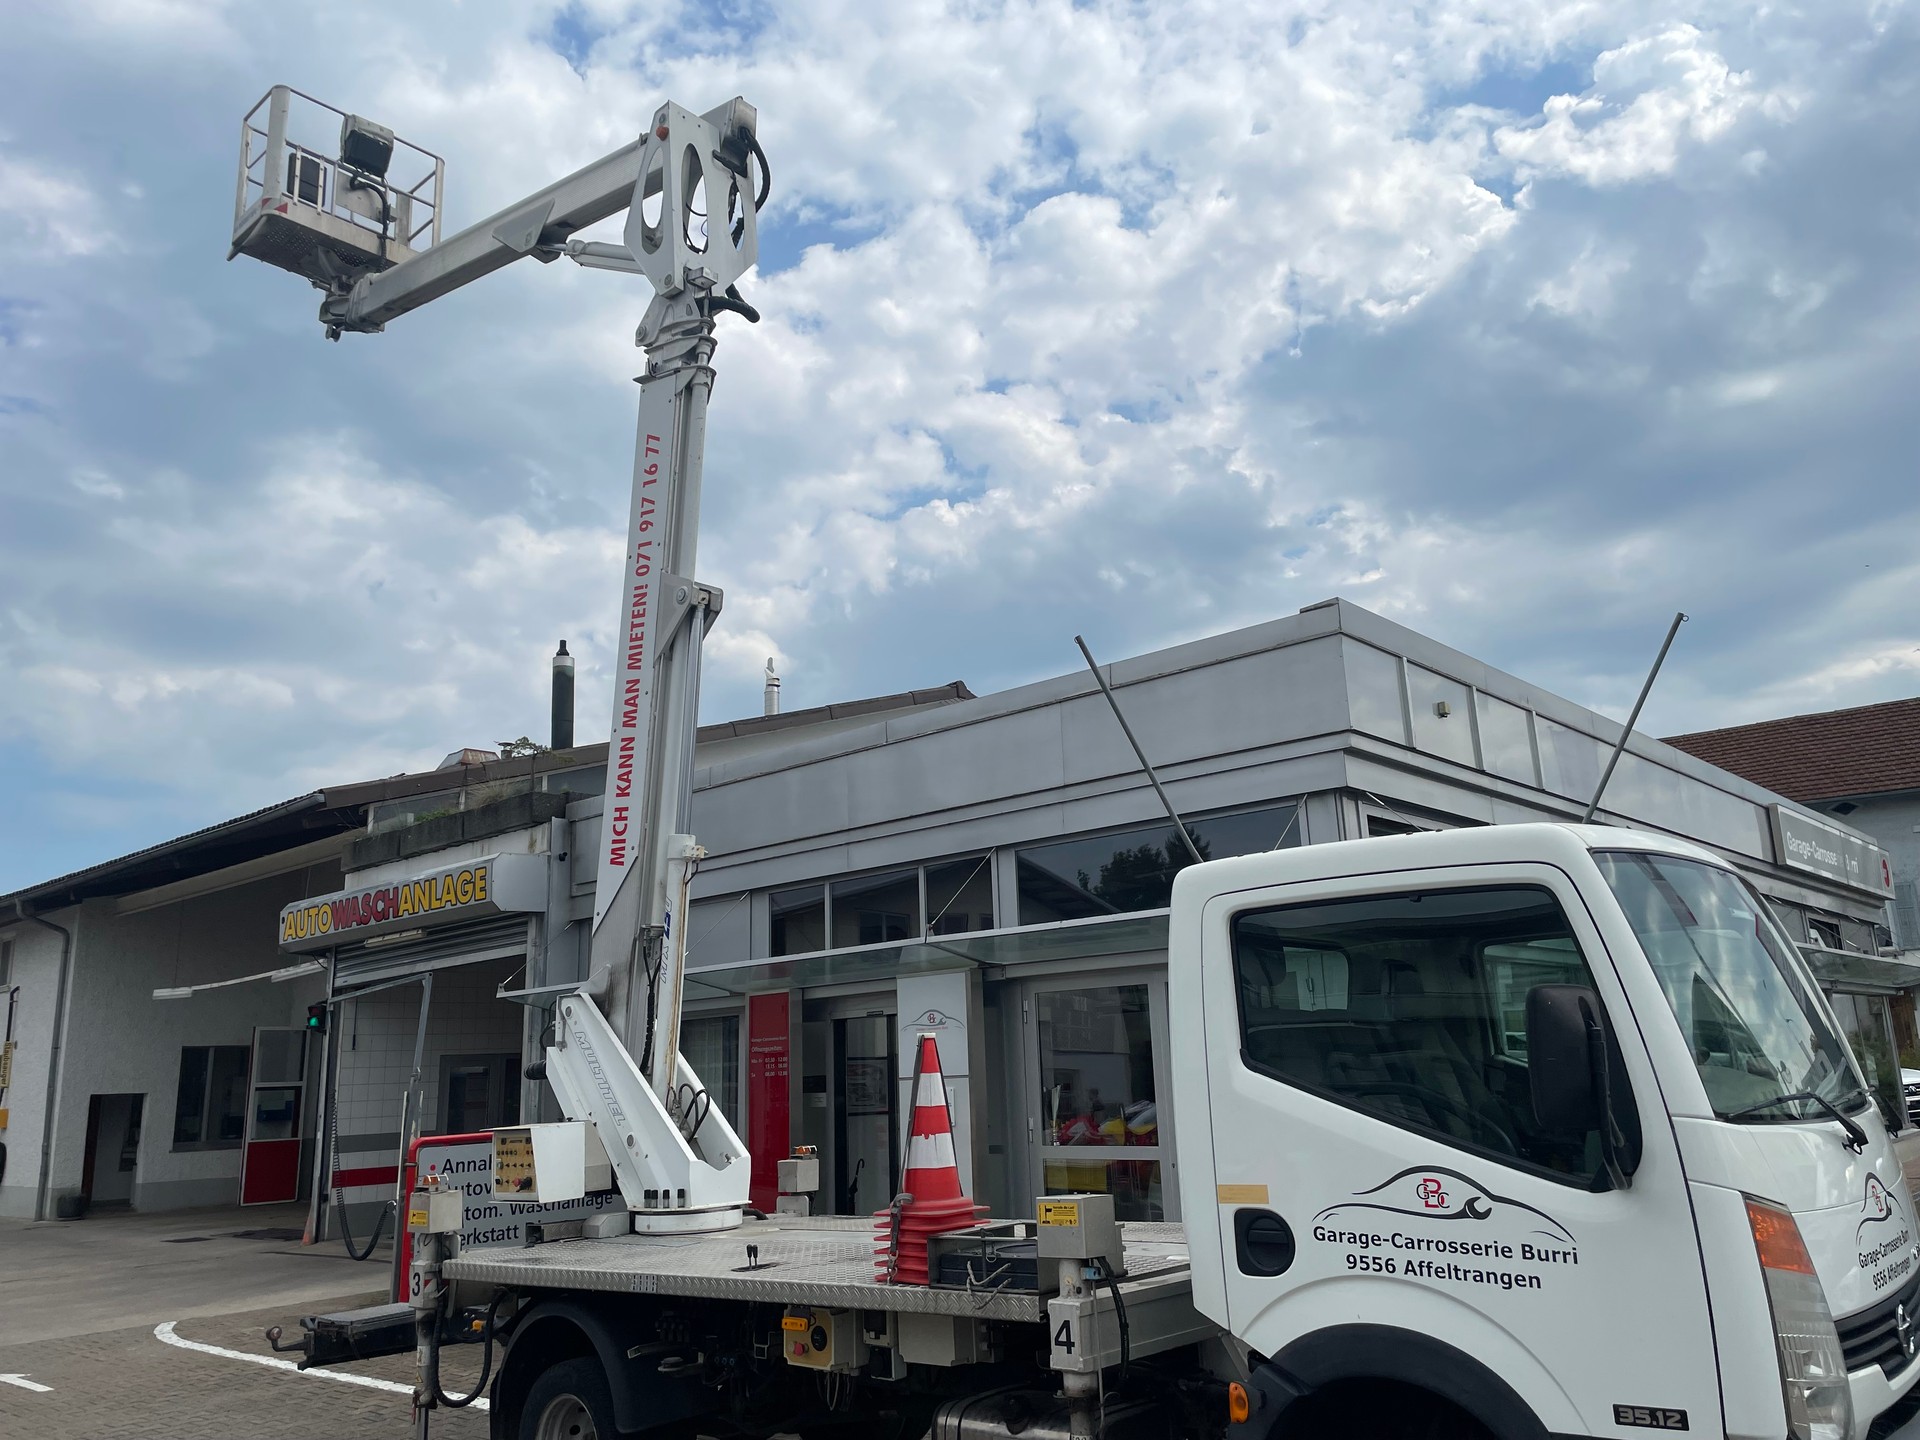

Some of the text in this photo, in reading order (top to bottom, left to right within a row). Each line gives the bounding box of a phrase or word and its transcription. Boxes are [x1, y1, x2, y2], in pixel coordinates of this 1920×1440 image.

[609, 433, 661, 866] MICH KANN MAN MIETEN! 071 917 16 77
[282, 866, 488, 943] AUTOWASCHANLAGE
[574, 1031, 626, 1127] MULTITEL
[460, 1225, 520, 1247] erkstatt
[1312, 1225, 1579, 1265] Garage-Carrosserie Burri
[412, 1271, 421, 1297] 3
[1345, 1254, 1542, 1290] 9556 Affeltrangen
[1872, 1269, 1888, 1291] 9556
[1054, 1318, 1076, 1356] 4
[1618, 1406, 1684, 1429] 35.12
